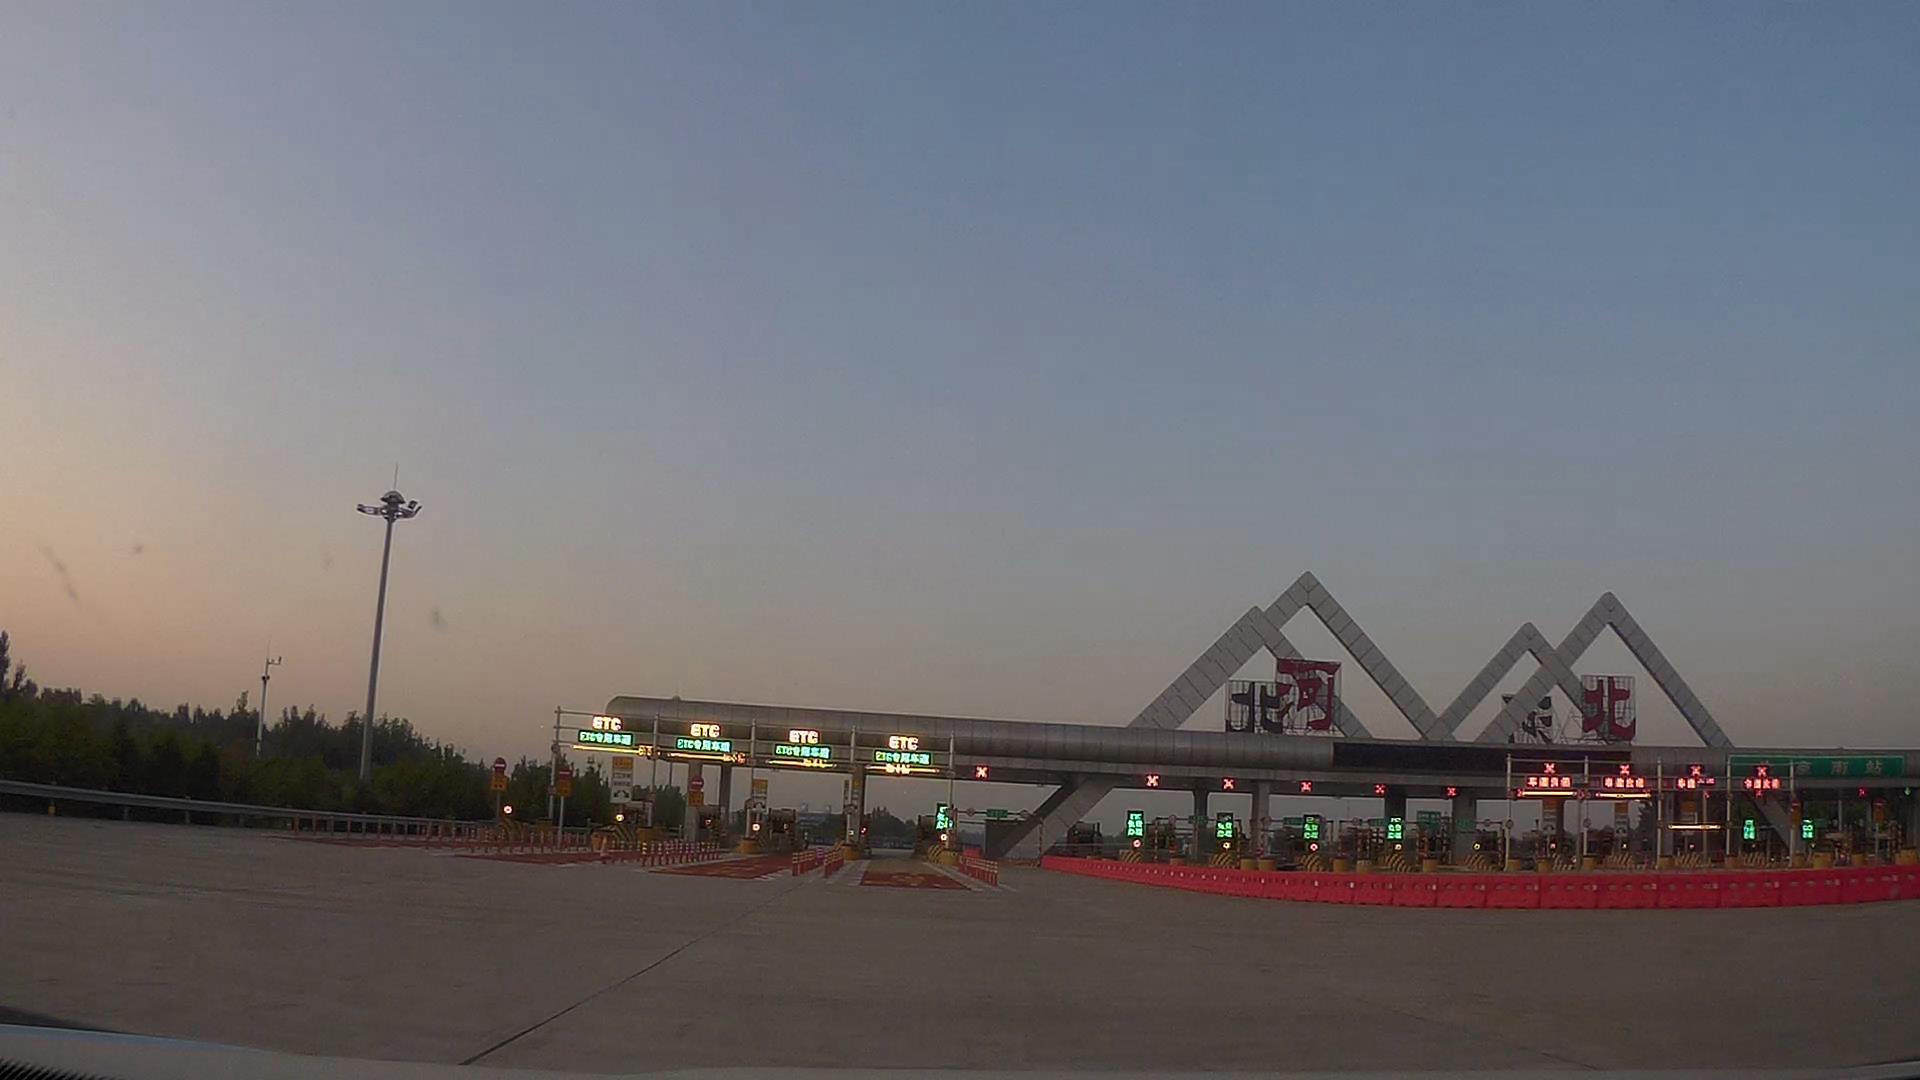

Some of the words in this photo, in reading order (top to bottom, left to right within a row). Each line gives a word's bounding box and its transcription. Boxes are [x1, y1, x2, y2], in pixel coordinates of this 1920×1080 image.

[592, 716, 622, 731] ETC
[690, 723, 720, 738] ETC
[789, 730, 819, 744] ETC
[888, 736, 919, 750] ETC
